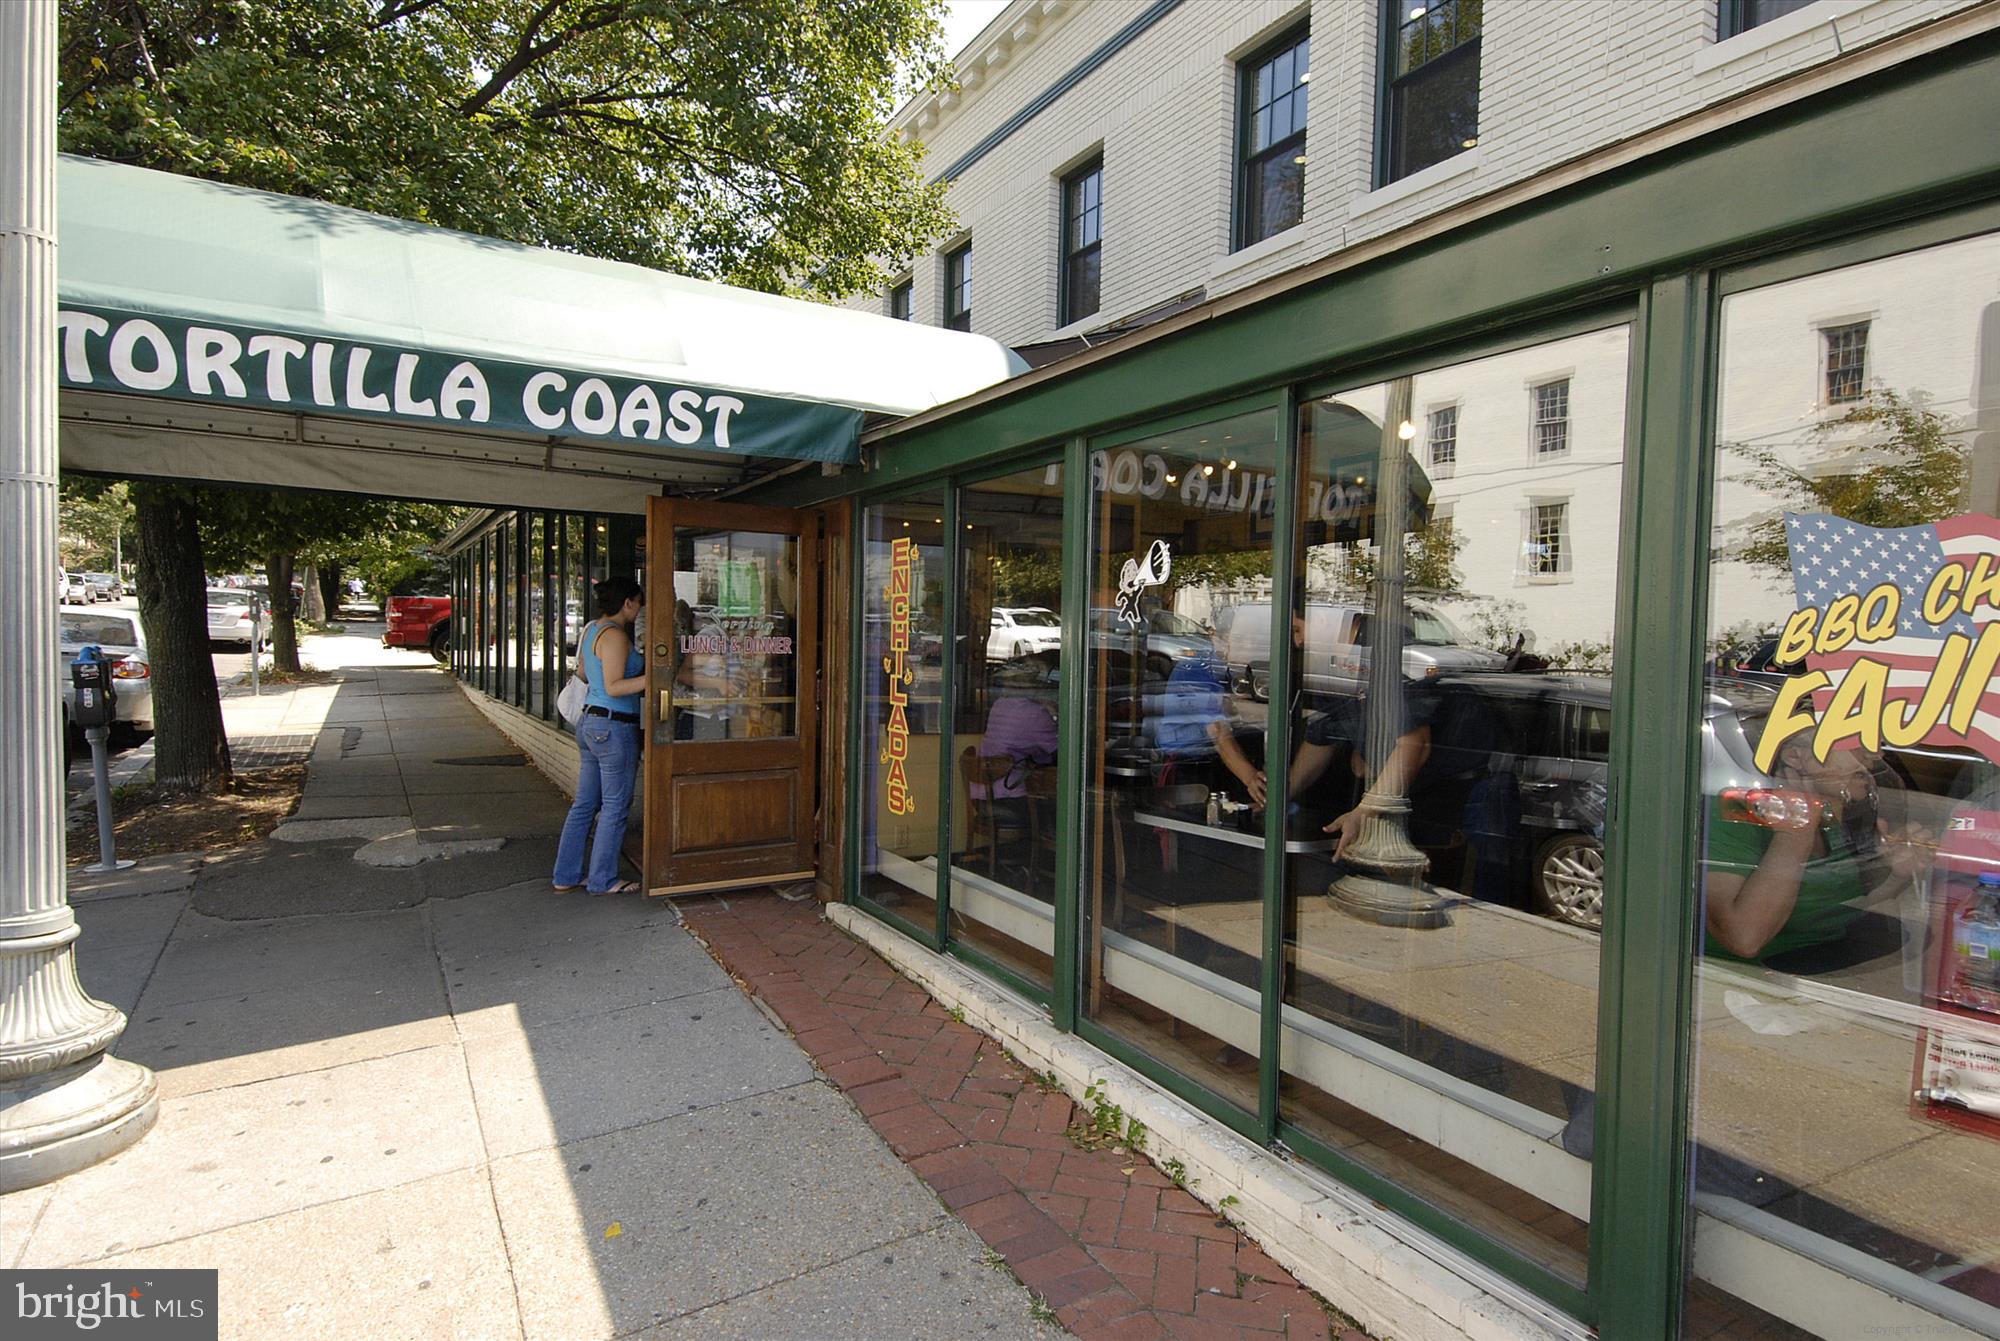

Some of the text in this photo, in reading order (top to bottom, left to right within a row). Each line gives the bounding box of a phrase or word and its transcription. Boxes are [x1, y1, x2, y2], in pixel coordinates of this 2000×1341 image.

[57, 310, 744, 450] TORTILLA COAST
[680, 634, 793, 655] LUNCH & DINNER
[702, 607, 775, 635] Serving
[887, 537, 912, 816] ENCHILADAS
[1773, 582, 1901, 667] BBQ
[1753, 619, 2000, 778] FAJI
